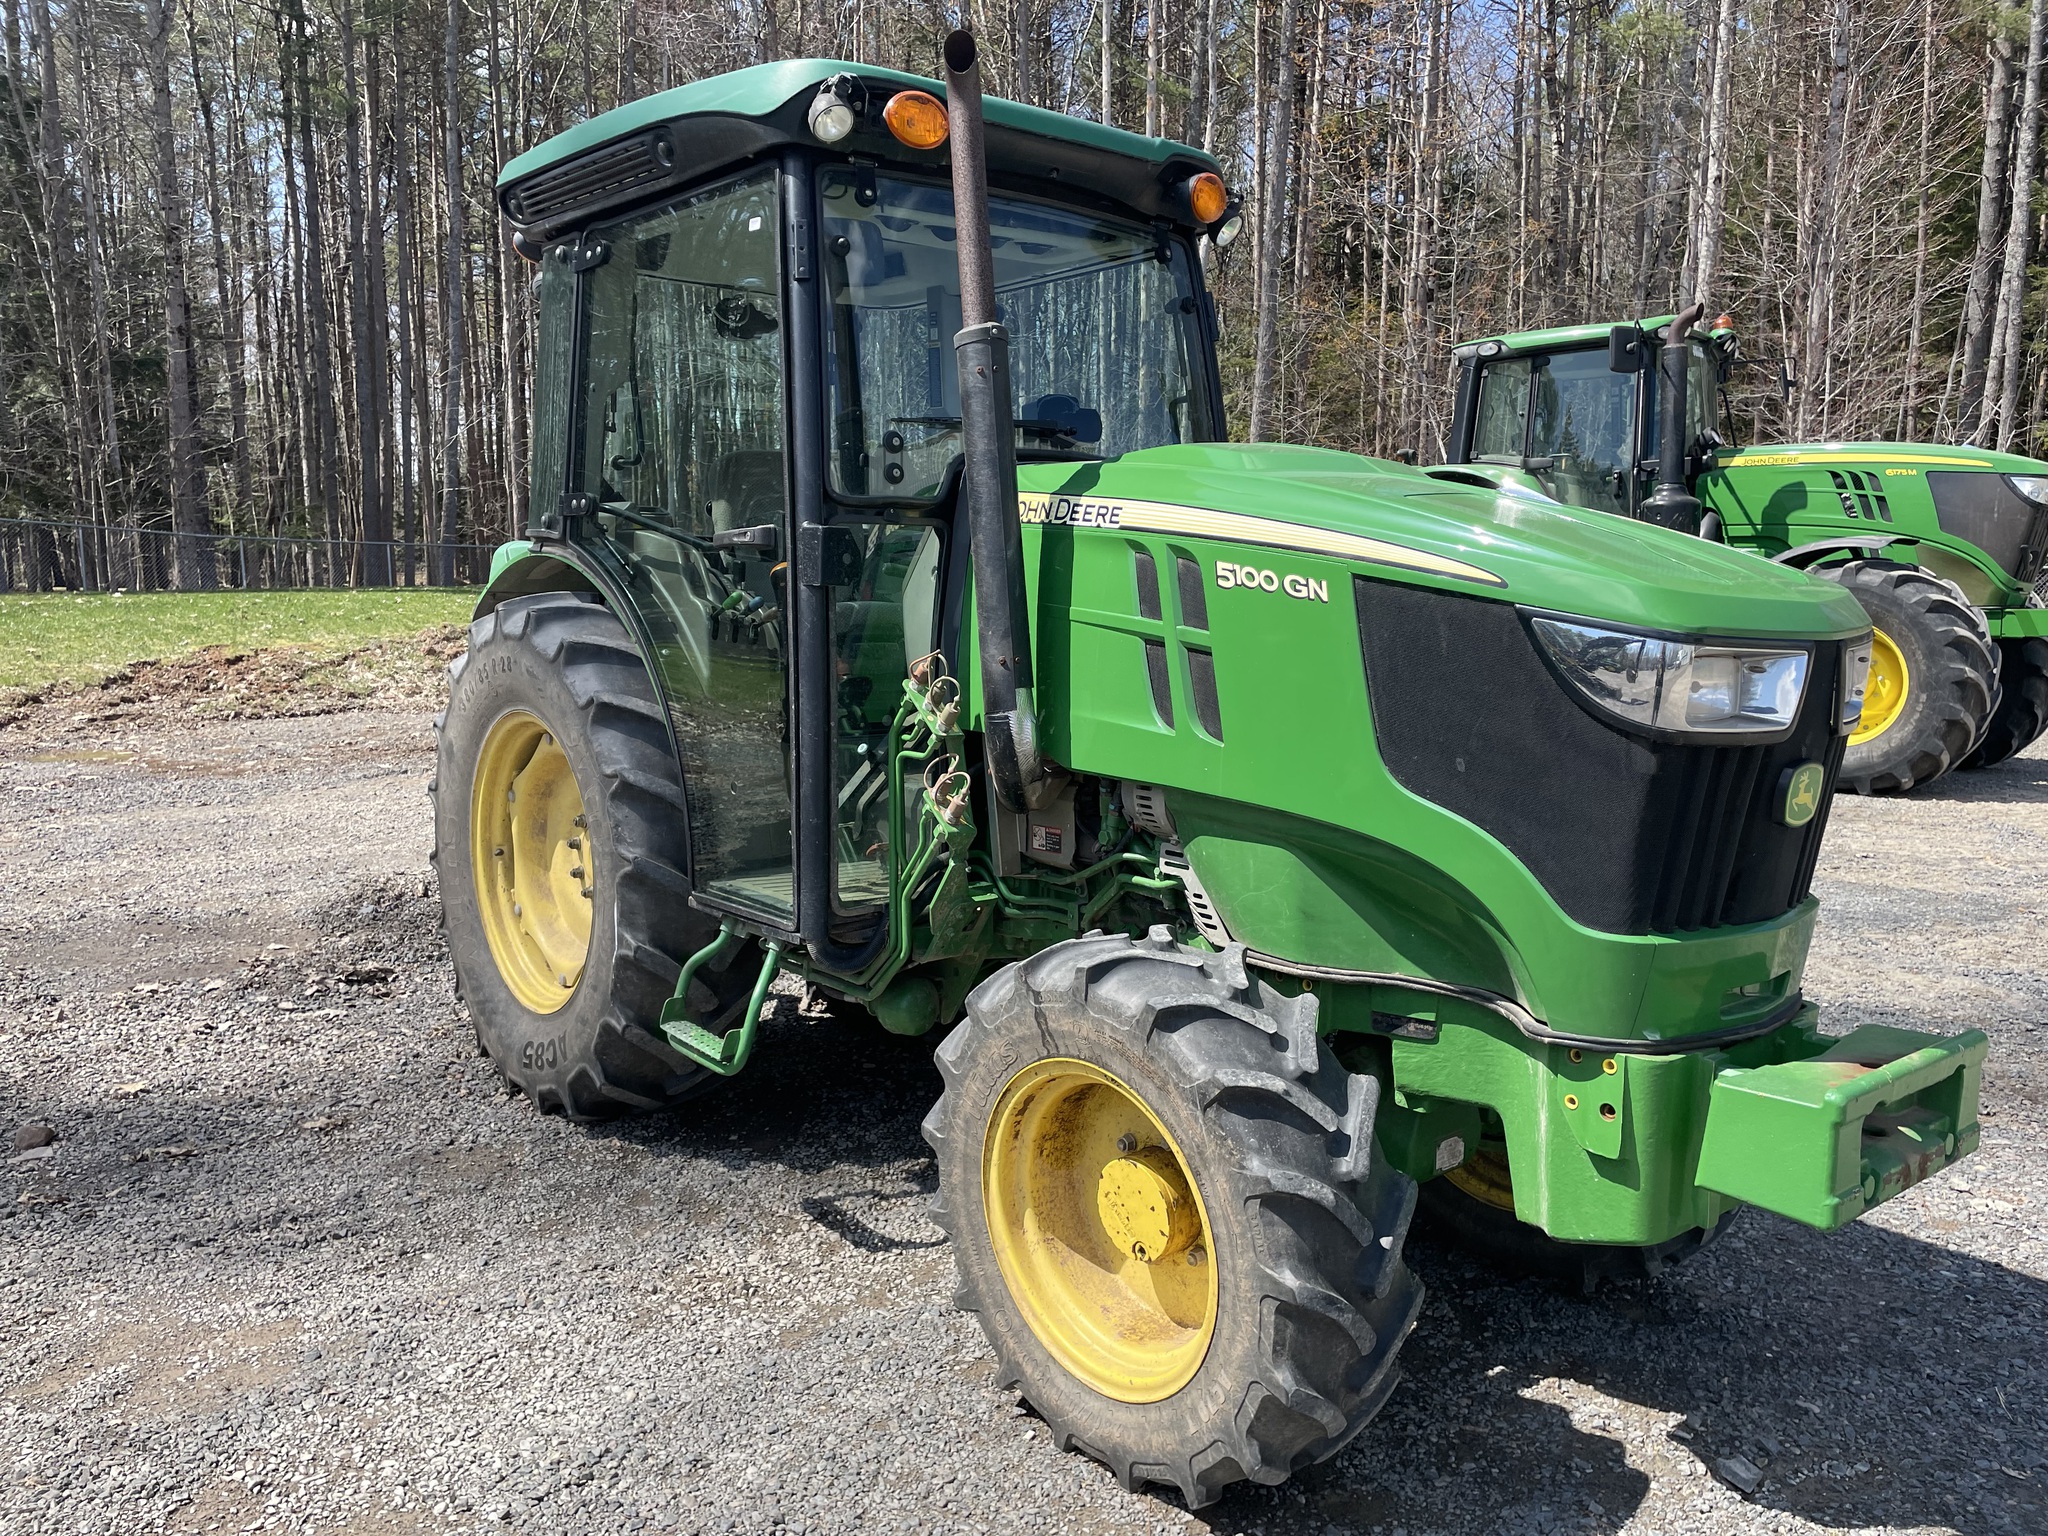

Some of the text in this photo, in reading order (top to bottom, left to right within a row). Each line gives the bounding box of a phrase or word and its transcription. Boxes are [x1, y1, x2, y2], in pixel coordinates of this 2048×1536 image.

[1768, 456, 1800, 464] DEERE
[1019, 498, 1123, 525] OHN DEERE
[1215, 560, 1329, 604] 5100 GN
[522, 1029, 568, 1072] AC85
